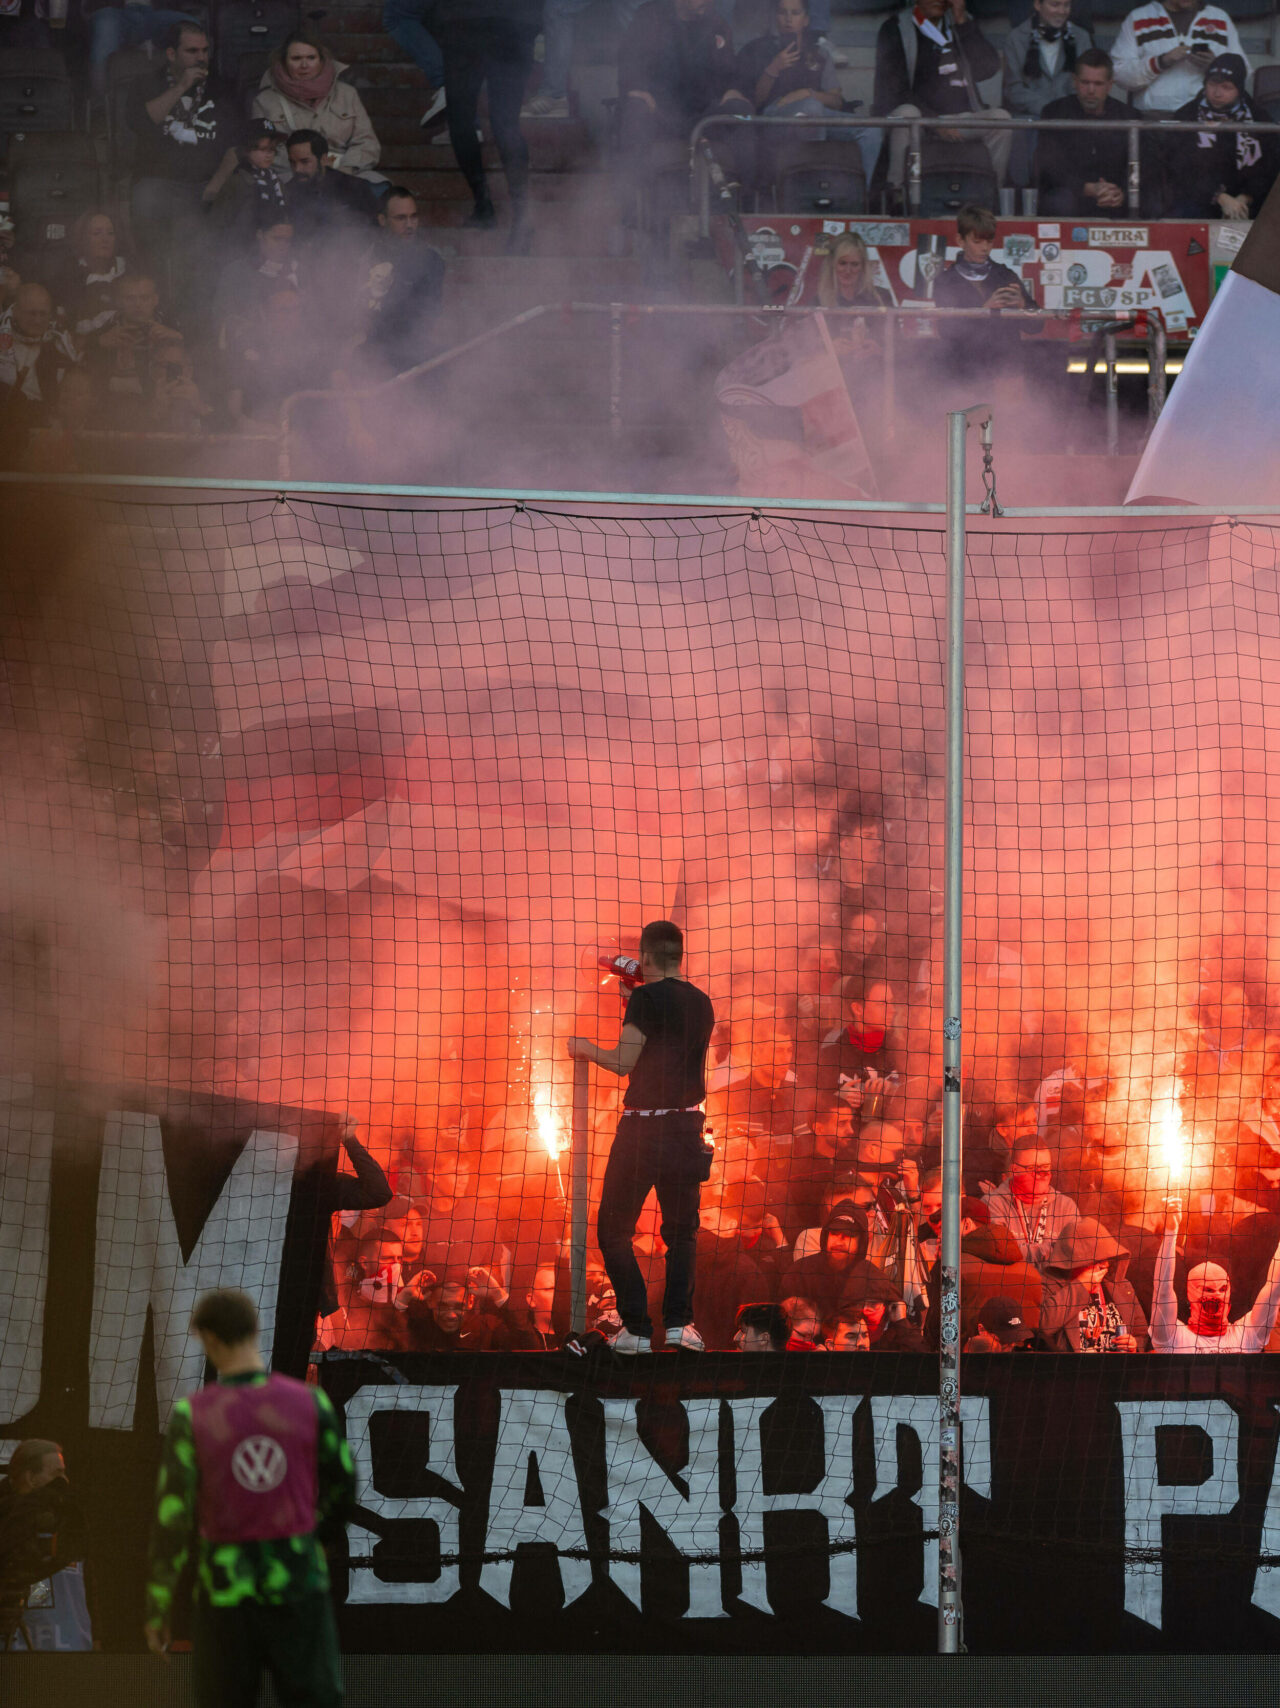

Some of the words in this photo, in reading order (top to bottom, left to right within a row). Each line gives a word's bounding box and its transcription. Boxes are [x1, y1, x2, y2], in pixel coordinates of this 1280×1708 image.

[1091, 230, 1145, 241] ULTRA
[1121, 291, 1149, 305] SP
[344, 1384, 992, 1620] SANKT
